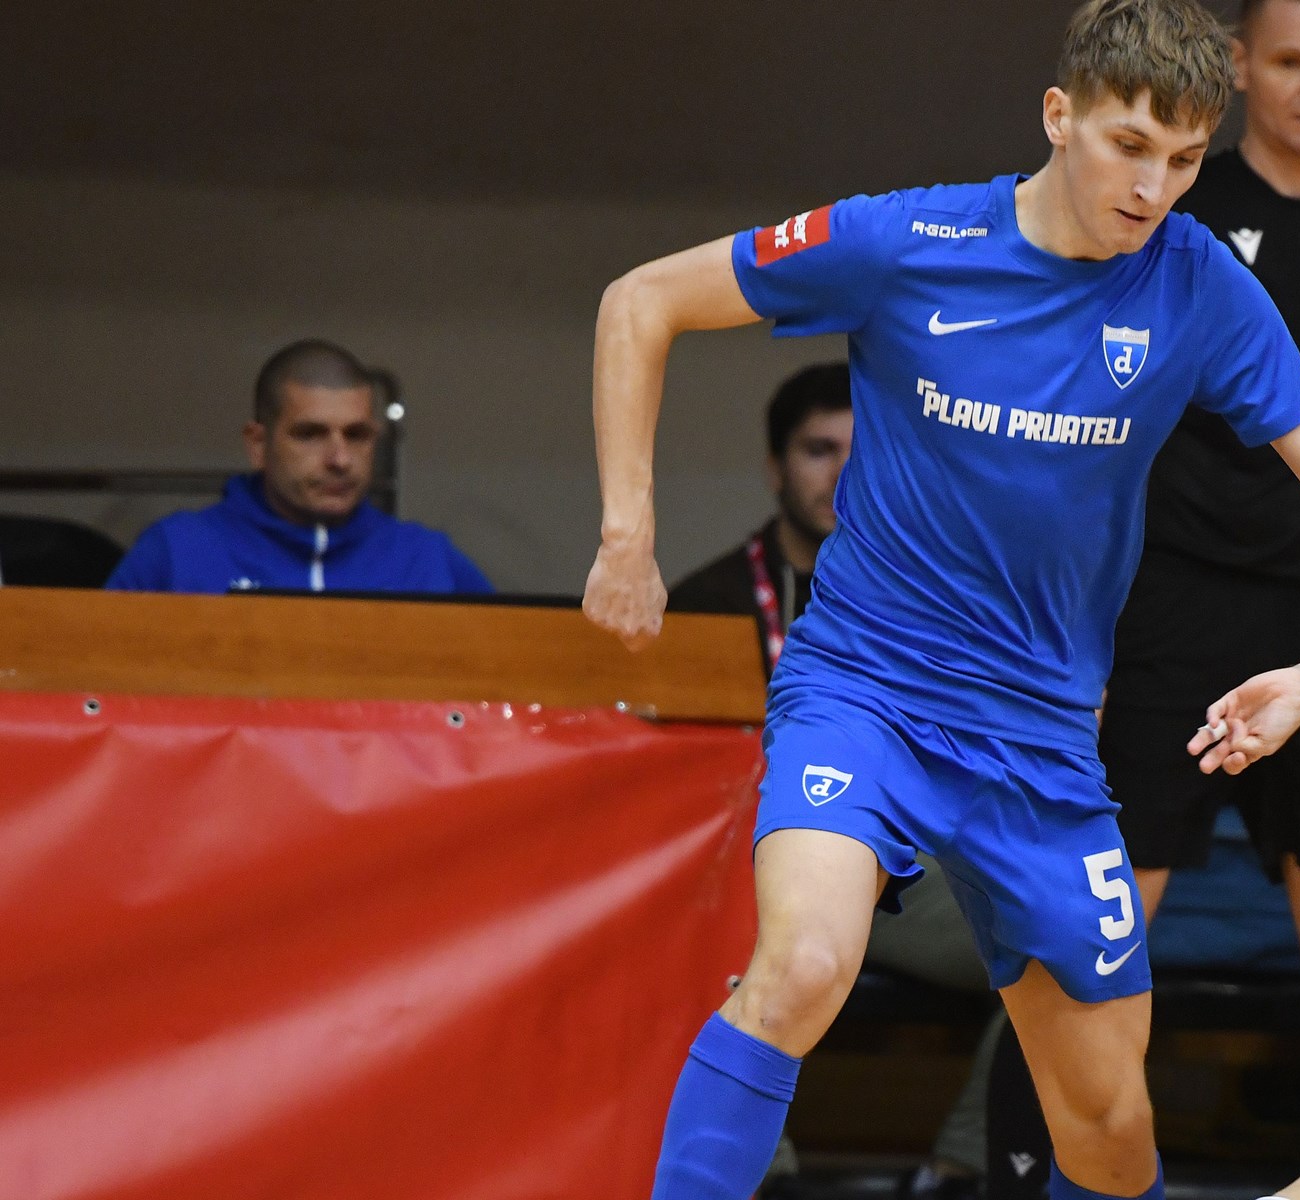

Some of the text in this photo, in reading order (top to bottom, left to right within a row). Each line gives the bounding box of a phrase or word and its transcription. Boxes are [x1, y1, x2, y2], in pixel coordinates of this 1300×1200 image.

[1114, 345, 1133, 374] d
[922, 387, 1132, 446] PLAVI PRIJATELJ
[810, 777, 833, 797] d
[1083, 847, 1136, 941] 5
